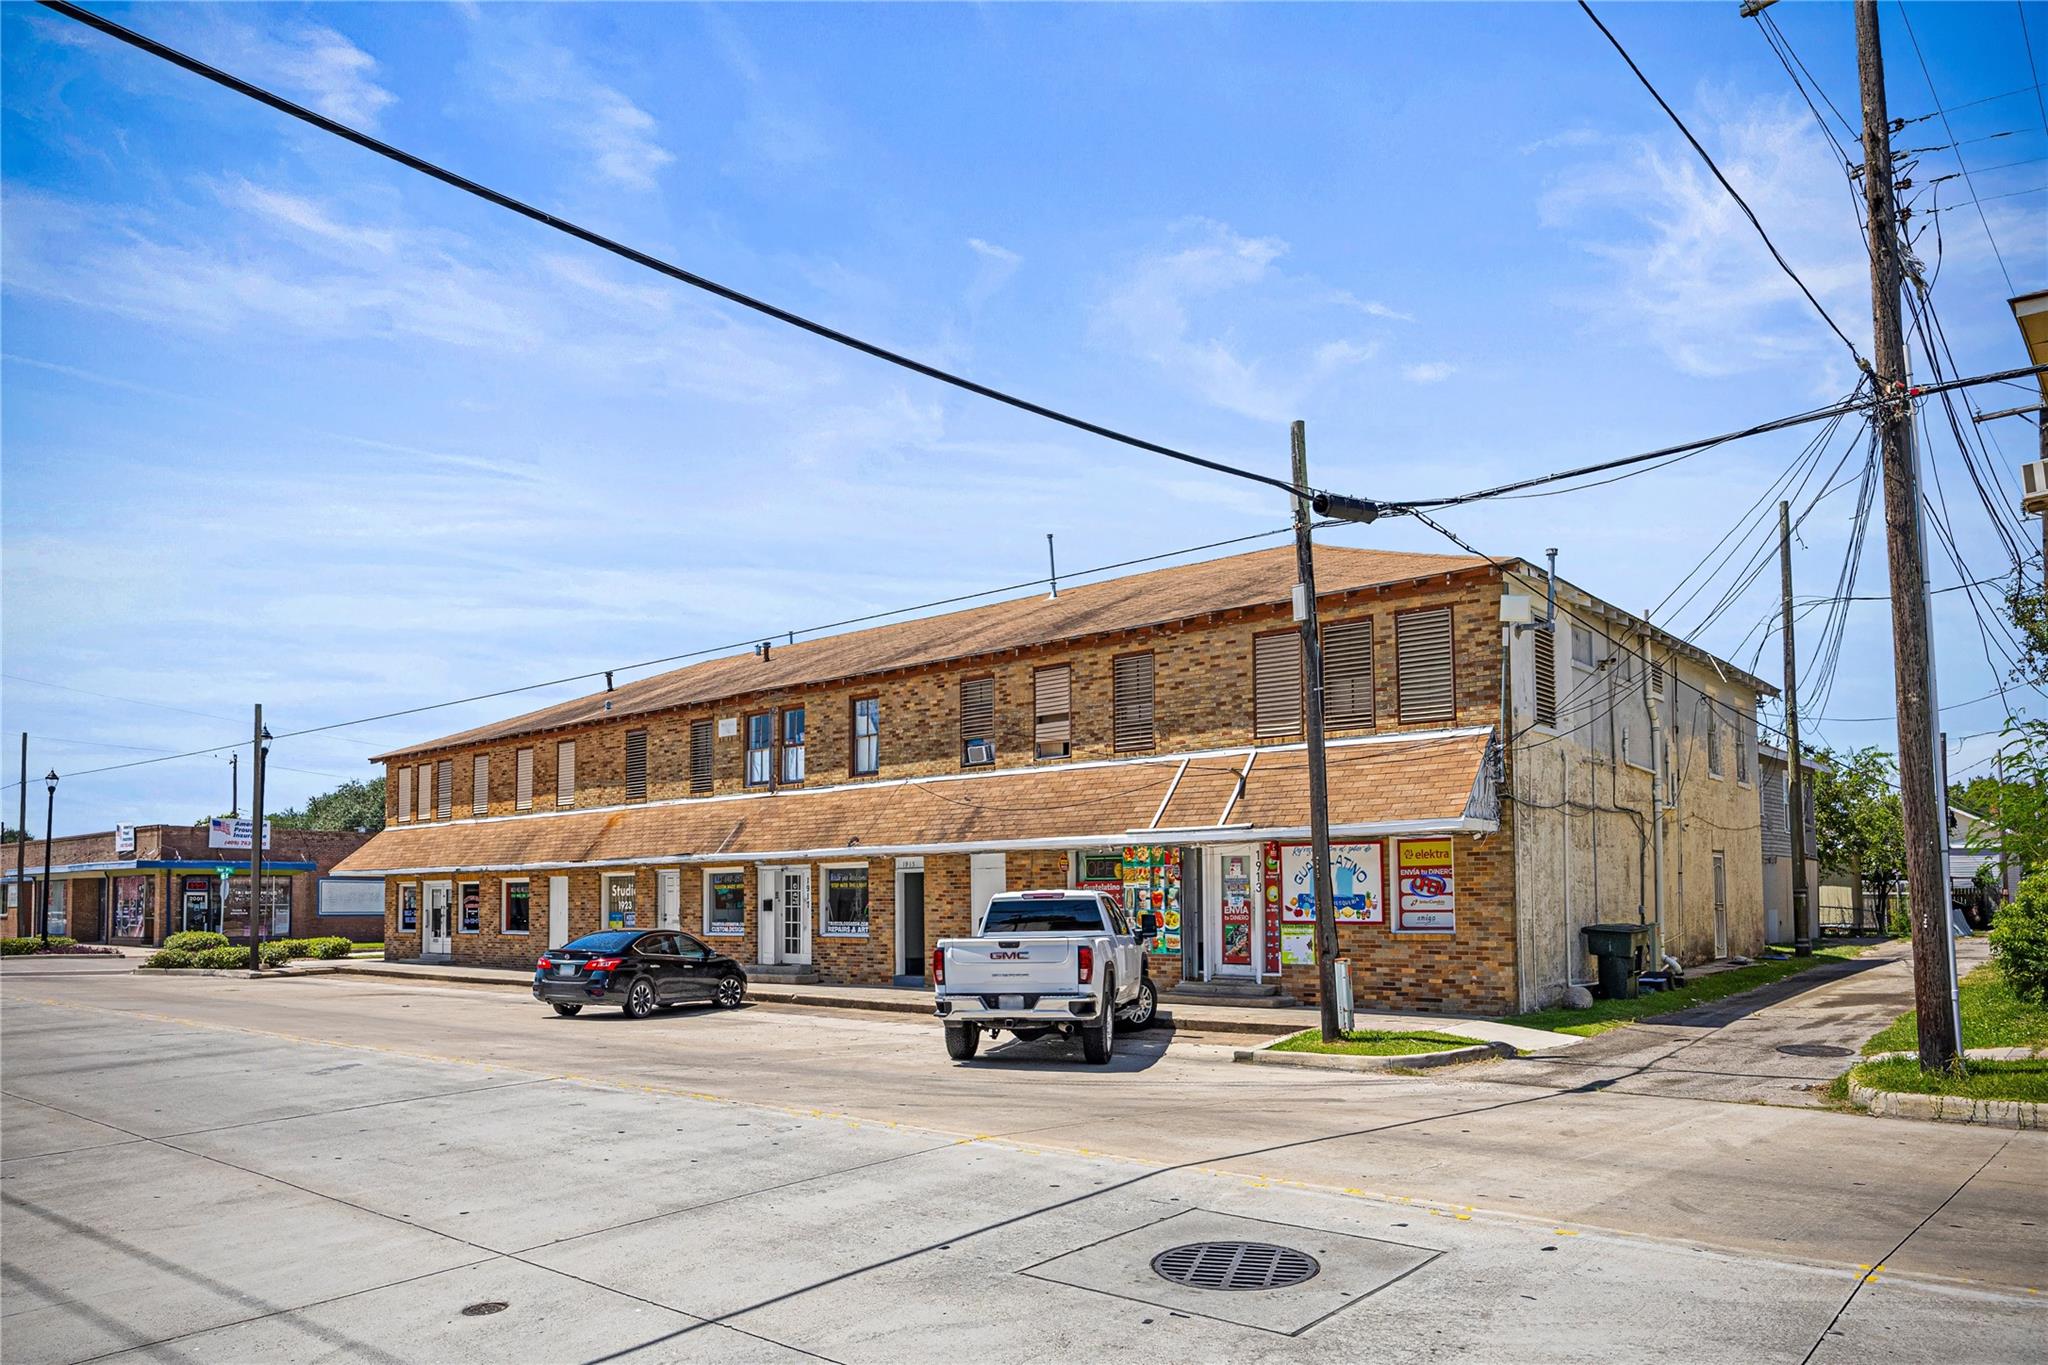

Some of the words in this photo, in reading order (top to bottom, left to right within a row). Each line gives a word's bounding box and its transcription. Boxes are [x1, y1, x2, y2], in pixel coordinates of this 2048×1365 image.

[1415, 850, 1449, 859] elektra
[1294, 854, 1367, 885] GUAATINO
[618, 901, 633, 911] 1923
[990, 951, 1029, 960] GMC
